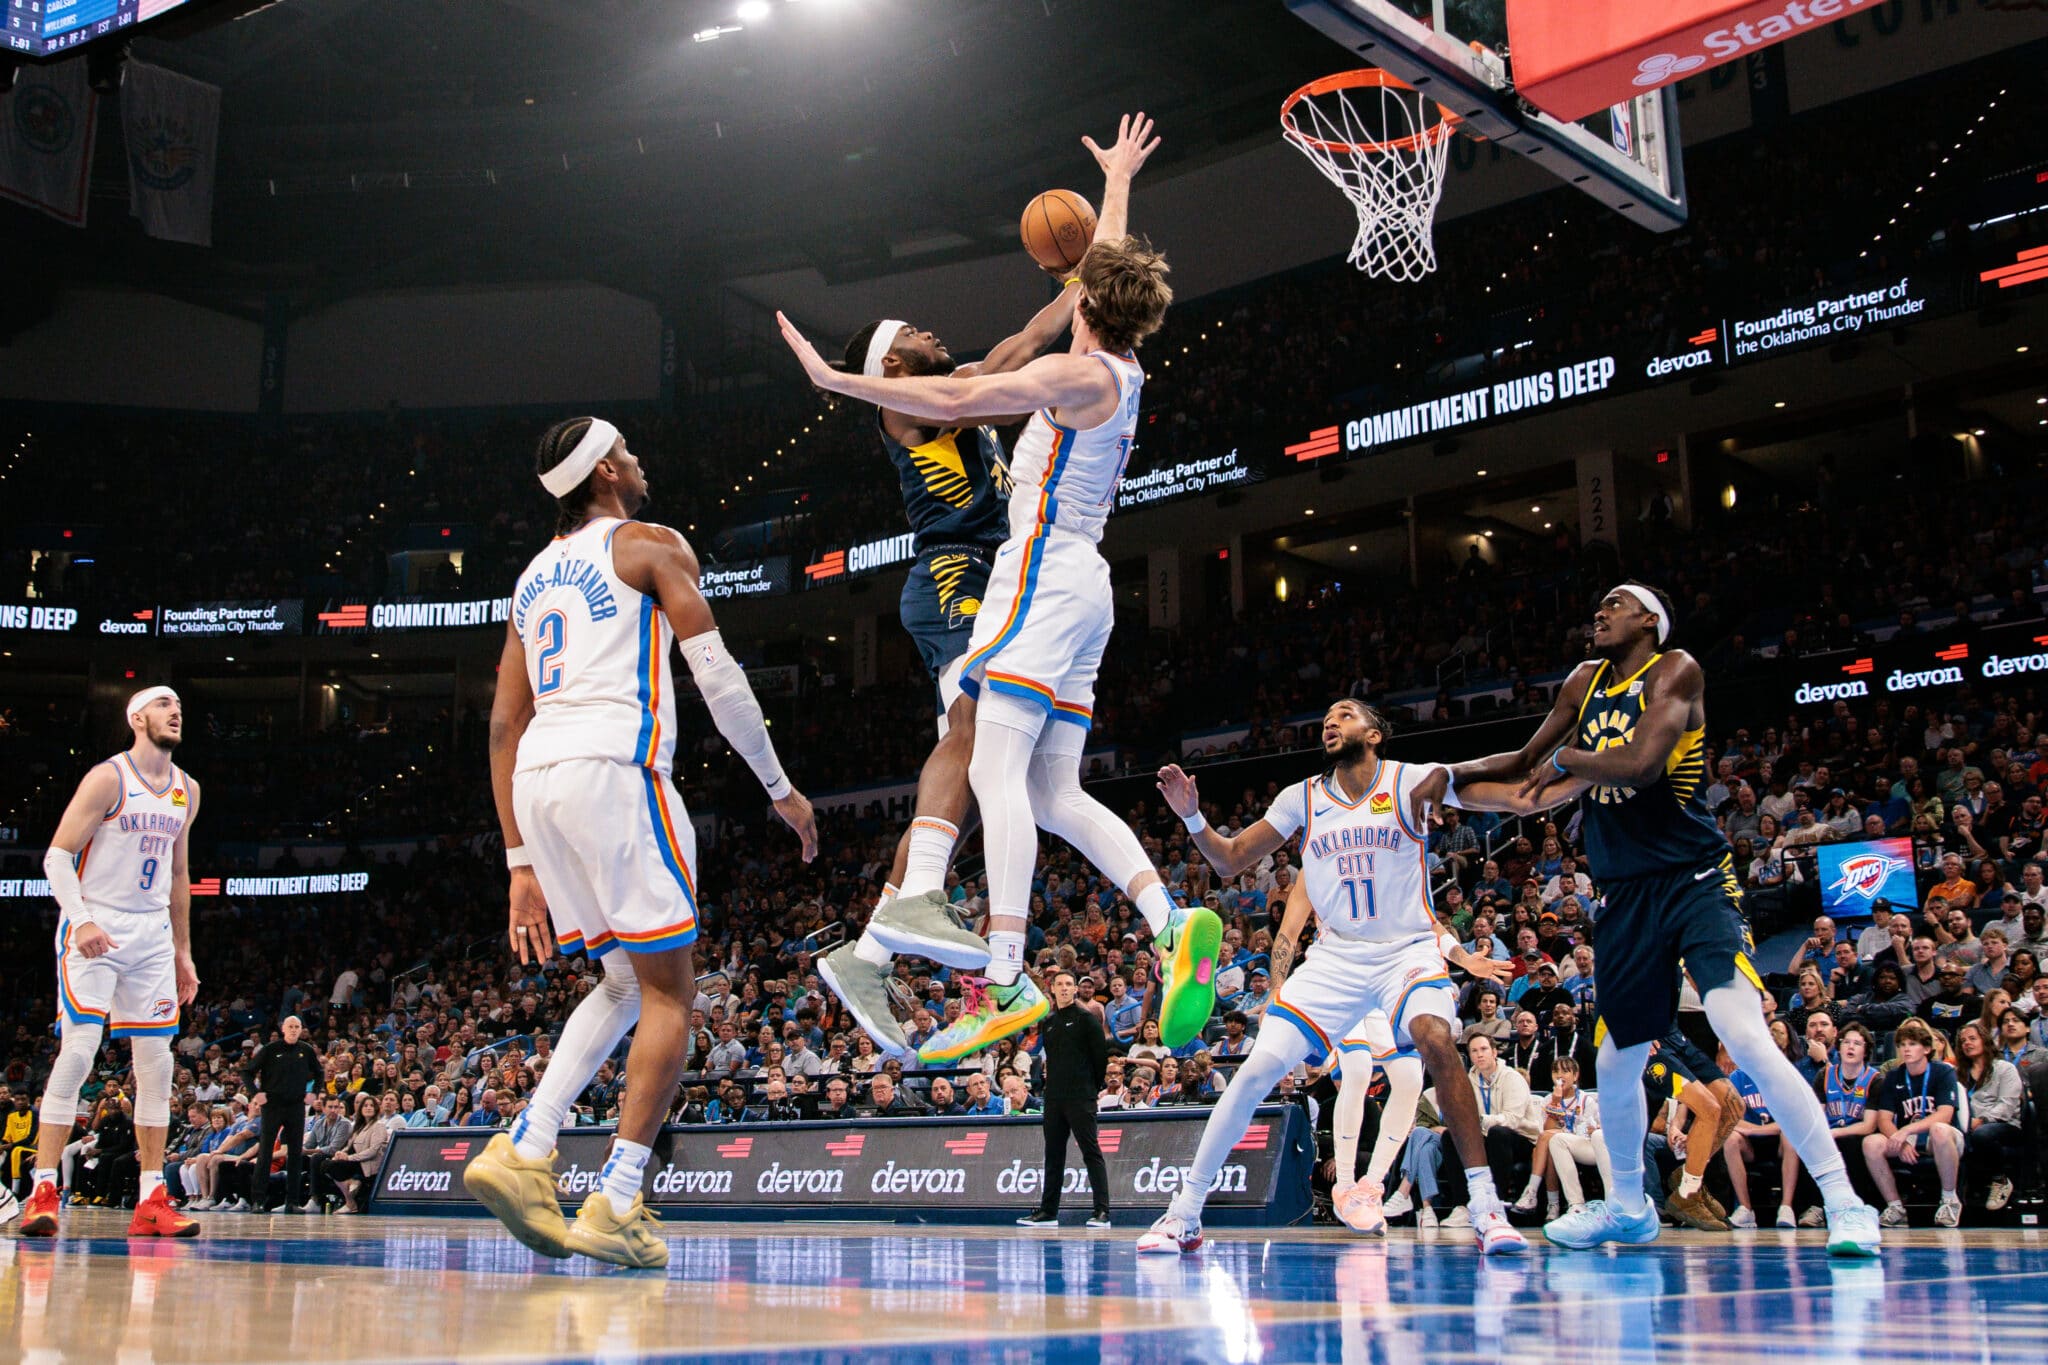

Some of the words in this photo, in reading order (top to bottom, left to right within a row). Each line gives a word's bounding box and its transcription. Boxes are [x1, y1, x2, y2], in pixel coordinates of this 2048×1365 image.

[1702, 0, 1843, 58] State
[1734, 306, 1816, 338] Founding
[1817, 287, 1887, 317] Partner
[1888, 277, 1909, 300] of
[1736, 340, 1759, 356] the
[1760, 322, 1831, 350] Oklahoma
[1833, 314, 1863, 331] City
[1864, 298, 1926, 324] Thunder
[1646, 348, 1713, 378] devon
[1346, 386, 1490, 451] COMMITMENT
[1494, 371, 1555, 416] RUNS
[1557, 355, 1616, 399] DEEP
[1119, 468, 1175, 493] Founding
[1175, 456, 1223, 478] Partner
[1223, 447, 1238, 465] of
[1119, 493, 1135, 507] the
[1136, 482, 1185, 503] Oklahoma
[1185, 476, 1206, 491] City
[1207, 465, 1249, 486] Thunder
[706, 567, 750, 585] Partner
[750, 564, 764, 580] of
[714, 583, 734, 598] City
[735, 579, 772, 594] Thunder
[0, 605, 28, 629] NS
[31, 607, 78, 631] DEEP
[99, 619, 148, 634] devon
[163, 621, 178, 633] the
[179, 620, 226, 634] Oklahoma
[226, 620, 246, 635] City
[247, 619, 285, 632] Thunder
[164, 607, 217, 623] Founding
[218, 607, 262, 621] Partner
[263, 605, 278, 619] of
[371, 600, 491, 628] COMMITMENT
[534, 608, 567, 702] 2
[1981, 652, 2048, 678] devo
[1794, 679, 1869, 705] devon
[1885, 665, 1964, 692] devon
[139, 834, 170, 857] CITY
[1310, 825, 1402, 860] OKLAHOMA
[138, 856, 161, 893] 9
[1337, 852, 1376, 877] CITY
[1843, 860, 1880, 894] OKC
[226, 876, 309, 896] COMMITMENT
[309, 874, 339, 893] RUNS
[340, 872, 369, 892] DEEP
[1341, 876, 1378, 921] 11
[387, 1164, 452, 1192] devon
[652, 1163, 733, 1193] devon
[756, 1161, 845, 1194] devon
[870, 1160, 966, 1194] devon
